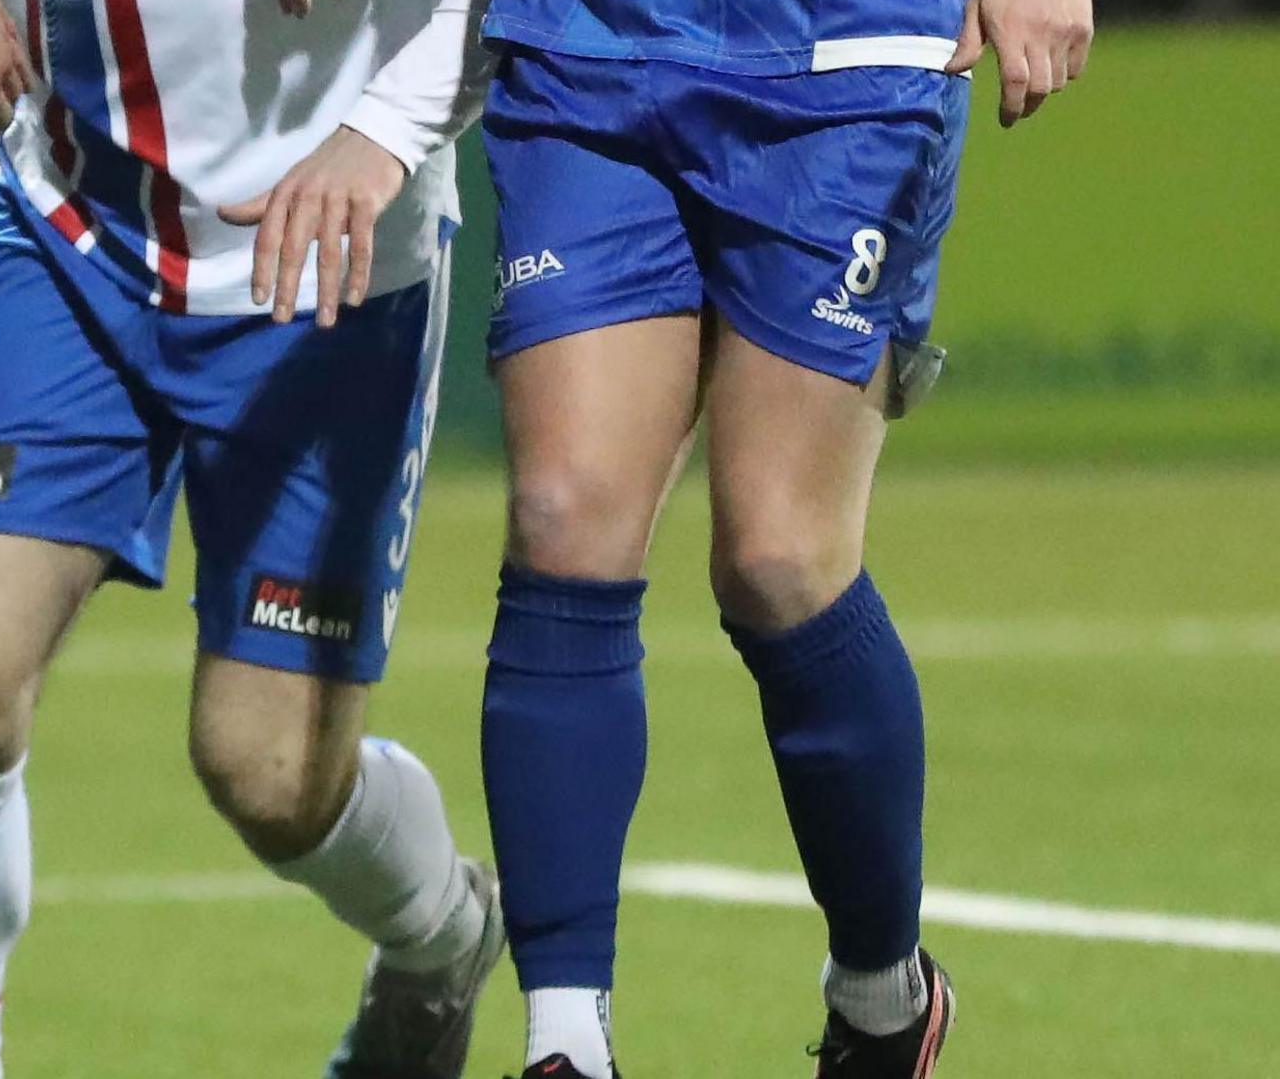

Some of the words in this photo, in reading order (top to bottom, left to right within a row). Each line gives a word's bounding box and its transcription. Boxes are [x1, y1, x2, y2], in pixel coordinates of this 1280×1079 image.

[498, 248, 565, 290] UBA
[844, 229, 888, 296] 8
[811, 298, 874, 335] Swifts
[388, 448, 421, 571] 3
[256, 578, 303, 608] Bet
[252, 599, 353, 640] McLean
